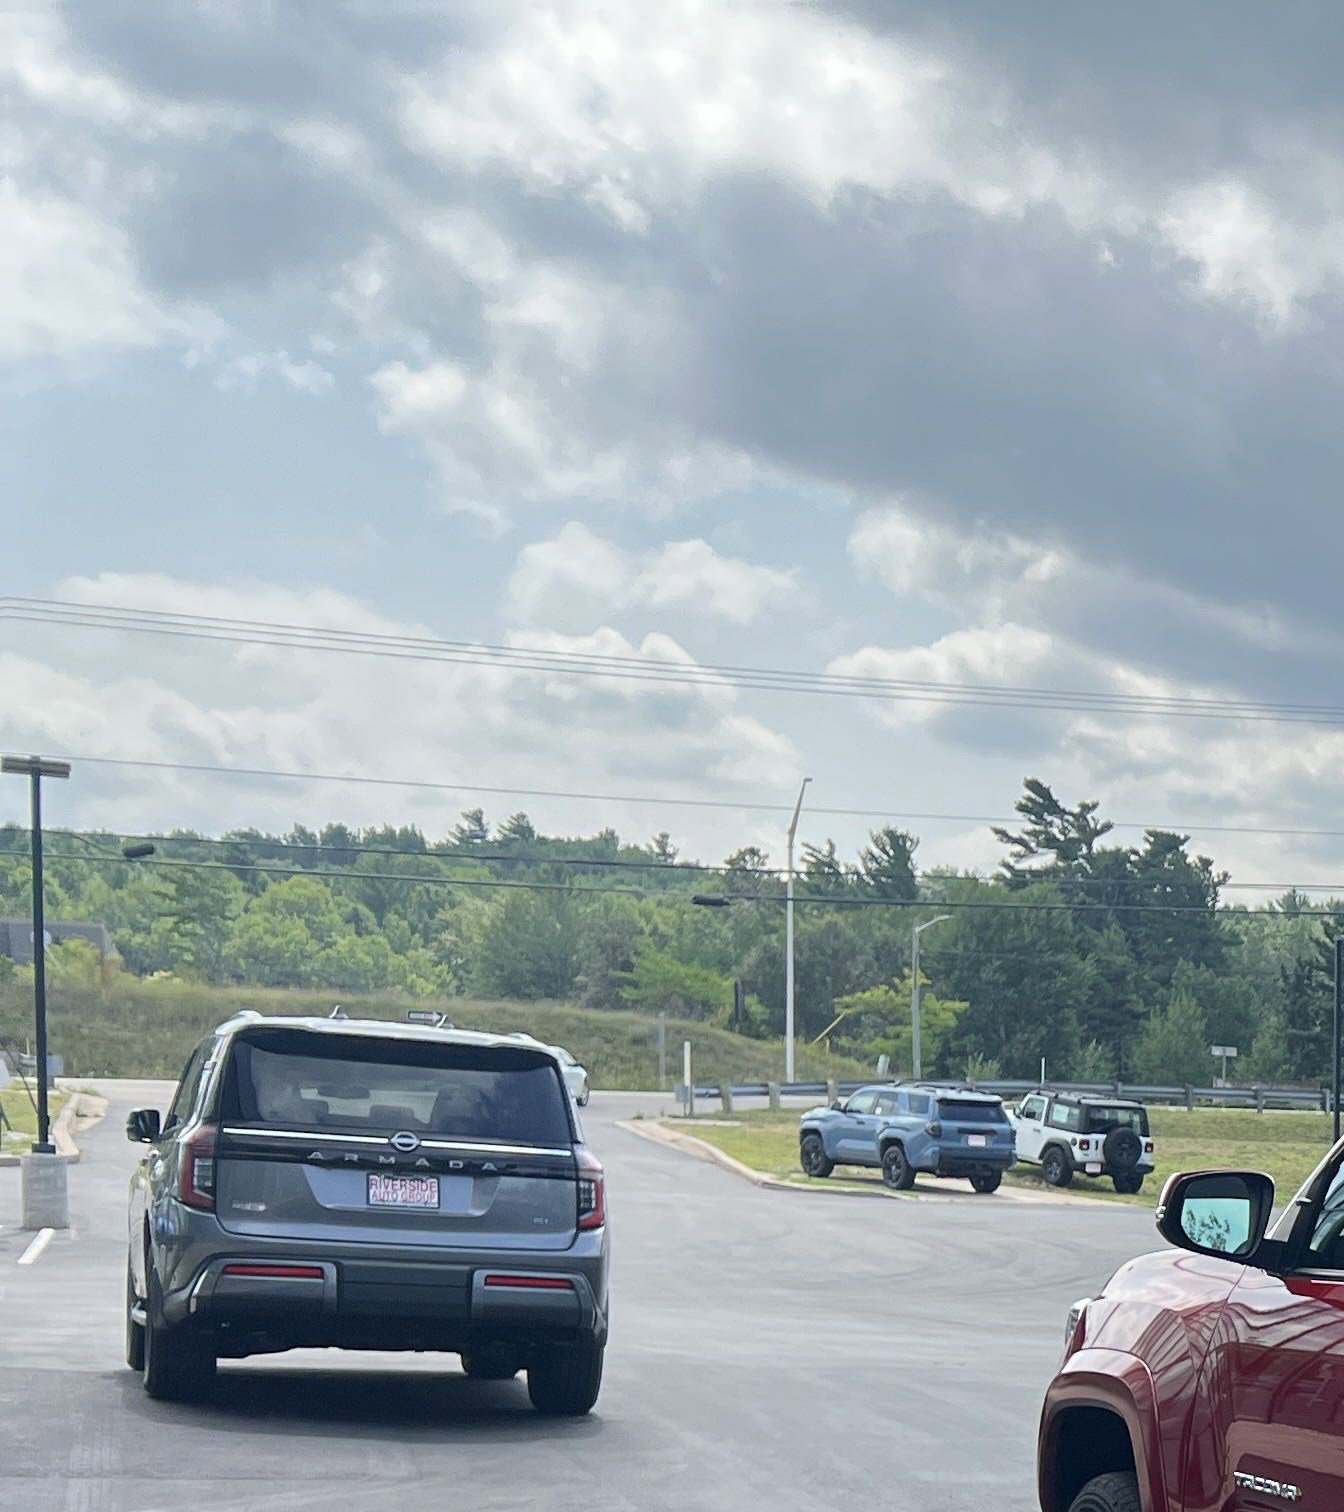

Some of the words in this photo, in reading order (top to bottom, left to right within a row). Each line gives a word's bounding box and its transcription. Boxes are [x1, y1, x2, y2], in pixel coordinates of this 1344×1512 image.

[307, 1151, 498, 1172] ARMADA
[369, 1176, 437, 1193] RIVERSIDE
[372, 1190, 398, 1202] AUTO
[400, 1190, 436, 1203] GROUP
[1233, 1471, 1302, 1501] TACOMA
